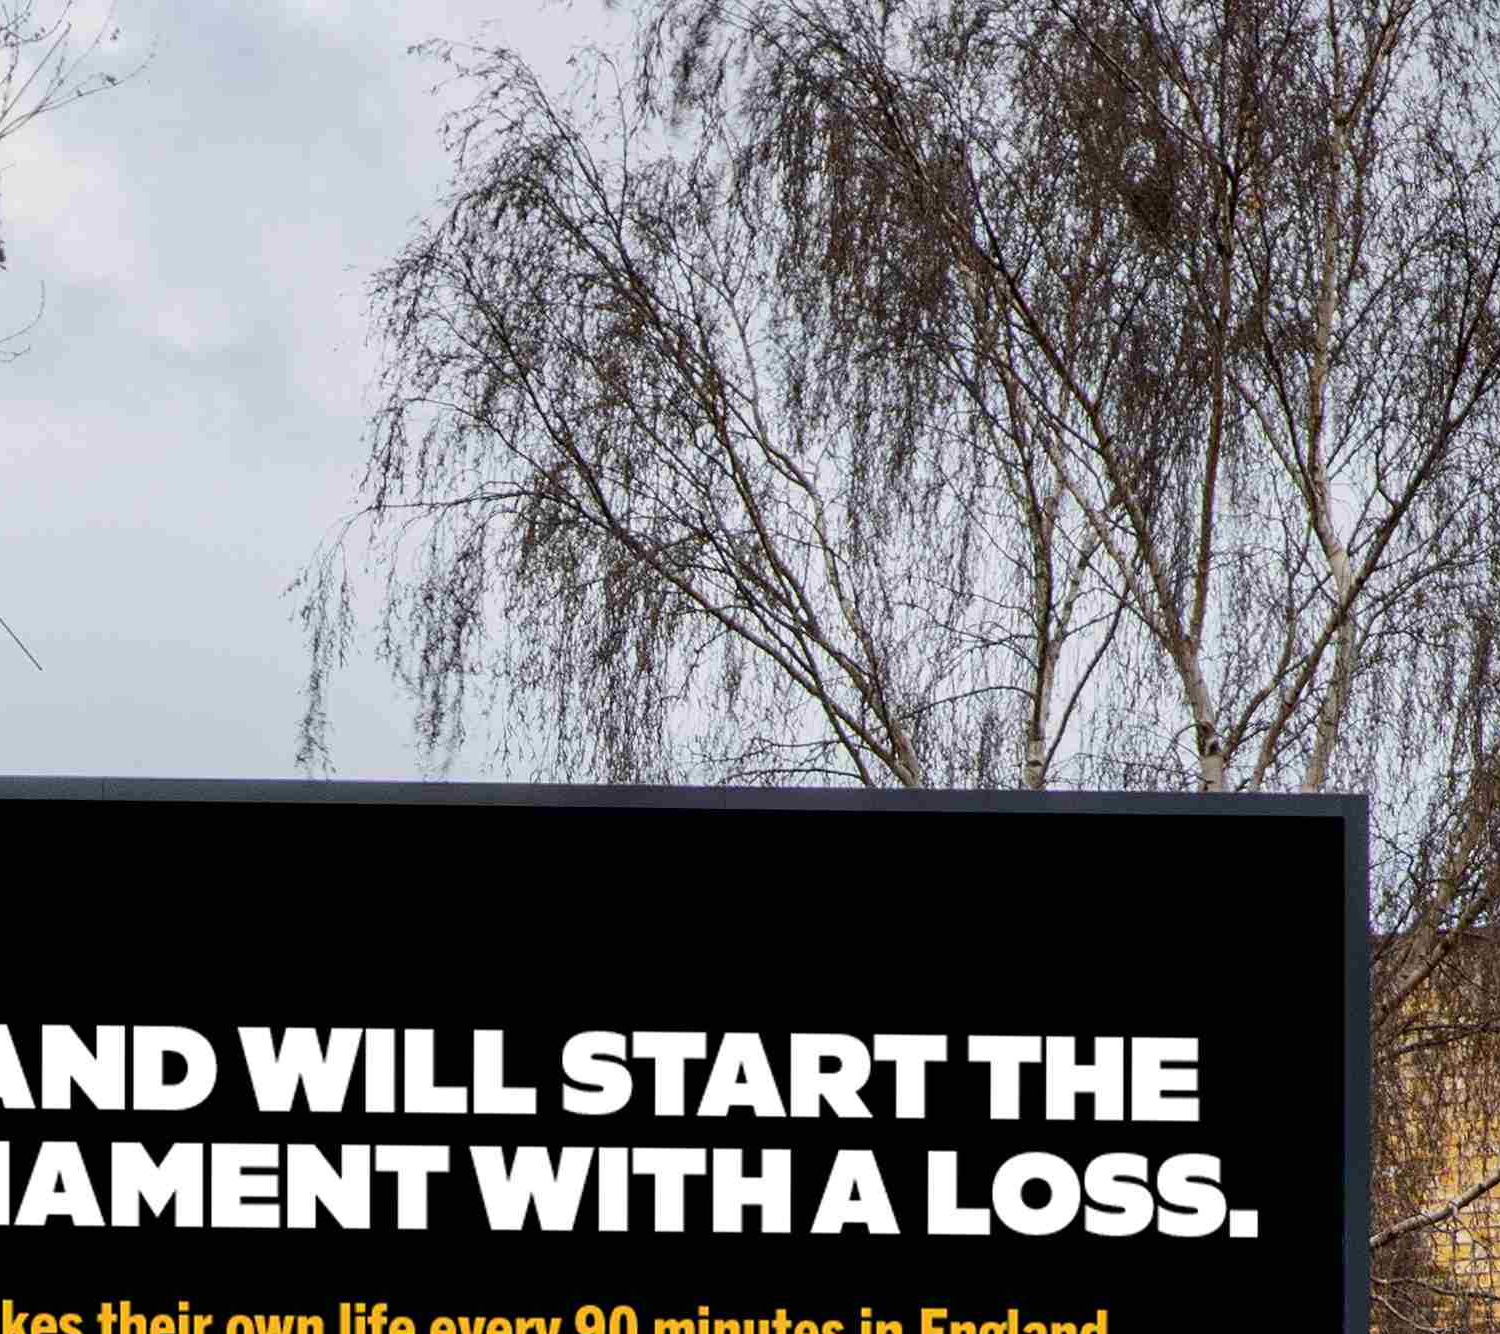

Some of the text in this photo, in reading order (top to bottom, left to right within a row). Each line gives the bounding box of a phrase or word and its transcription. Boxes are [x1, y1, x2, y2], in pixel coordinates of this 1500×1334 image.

[238, 1027, 537, 1114] WILL
[562, 1031, 947, 1119] START
[968, 1035, 1199, 1121] THE
[470, 1146, 791, 1233] WITH
[810, 1150, 900, 1234] A
[928, 1151, 1260, 1239] LOSS.
